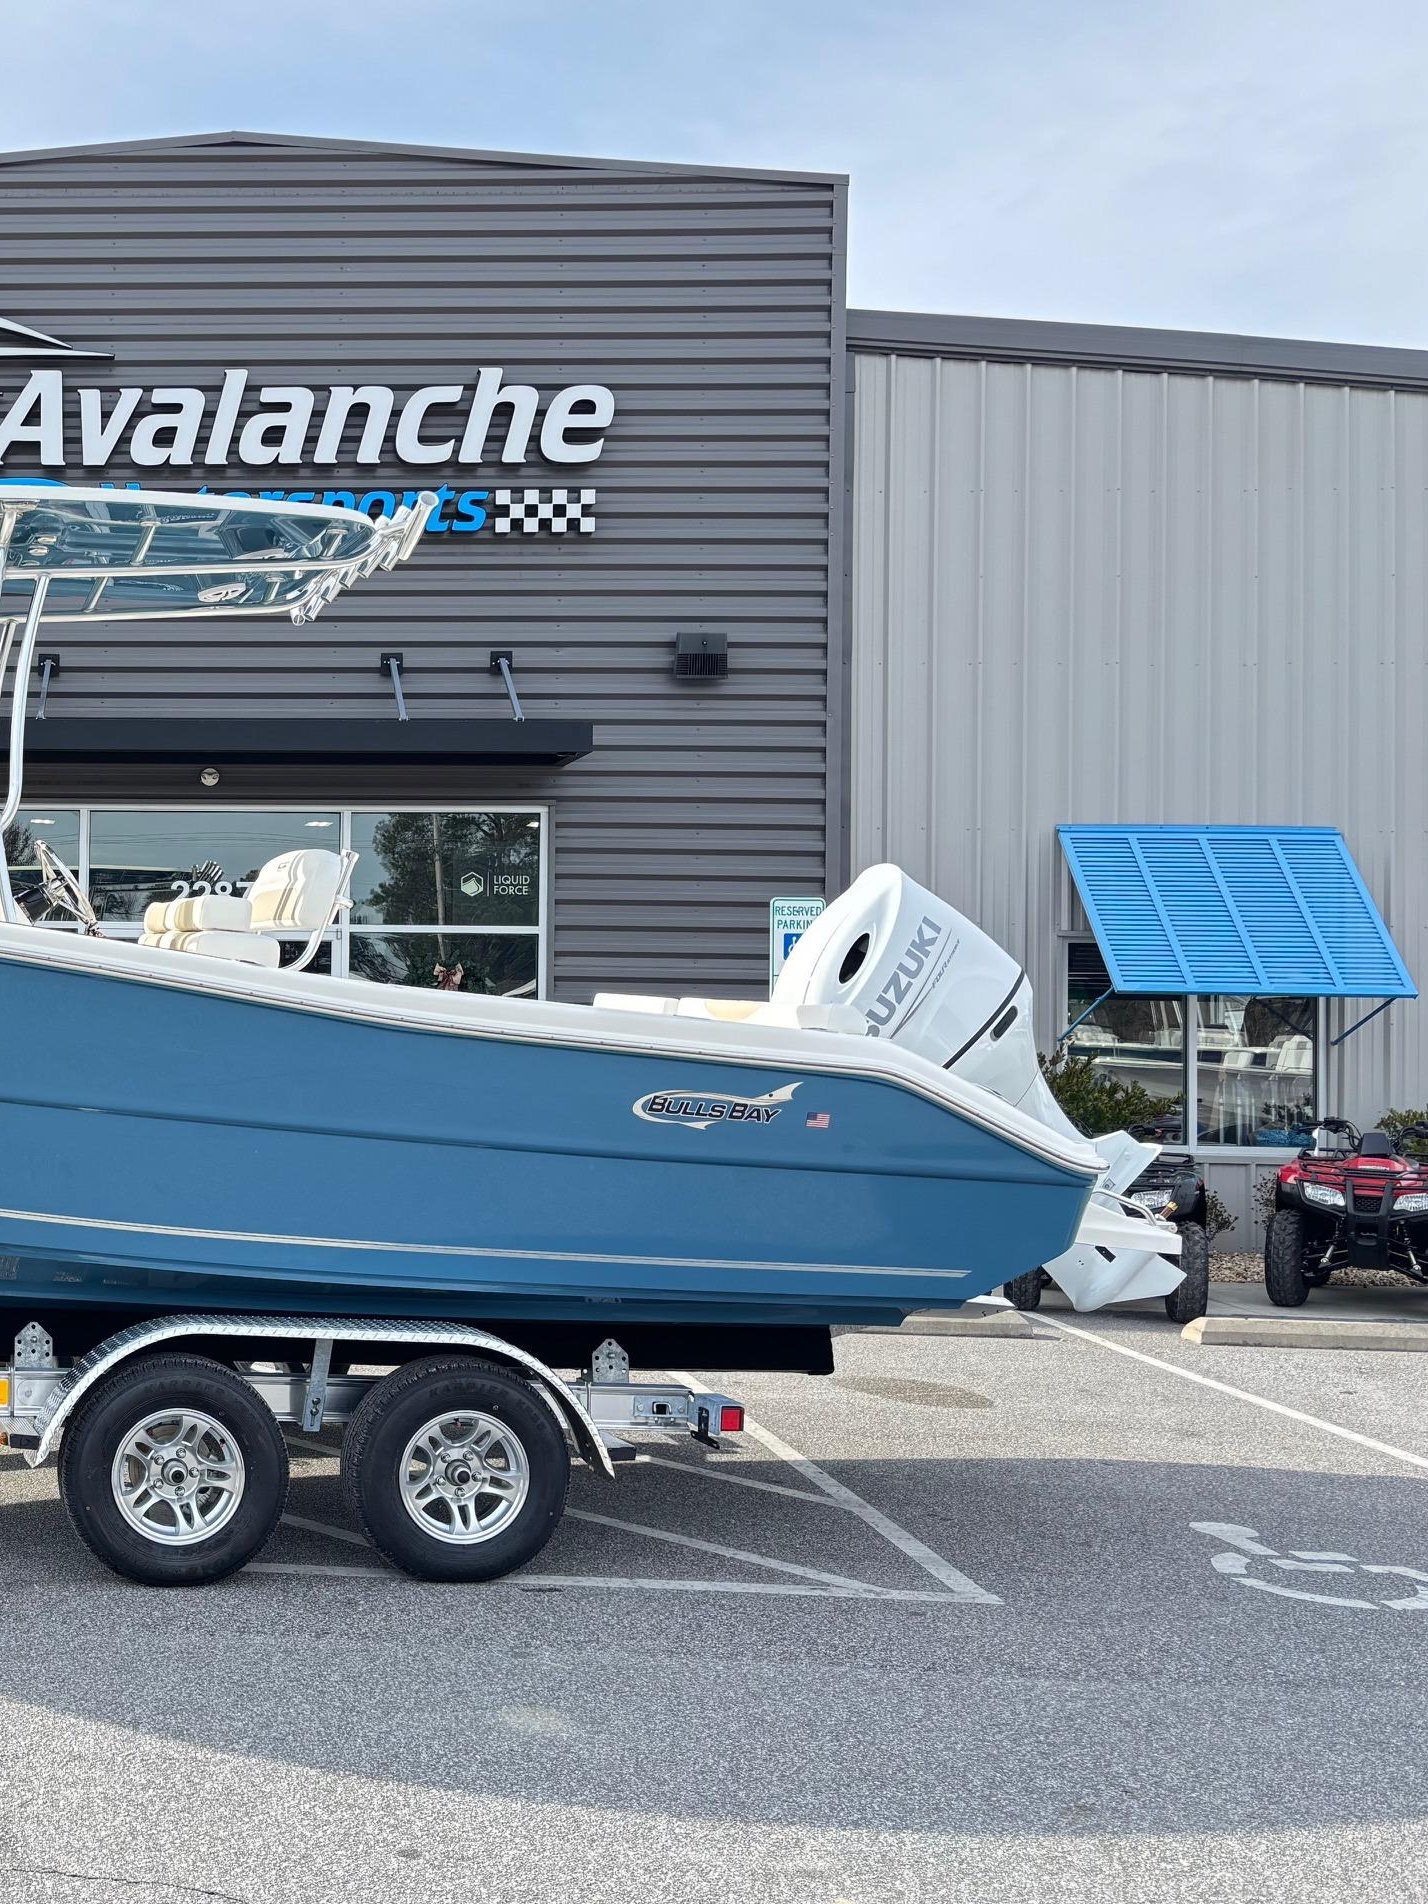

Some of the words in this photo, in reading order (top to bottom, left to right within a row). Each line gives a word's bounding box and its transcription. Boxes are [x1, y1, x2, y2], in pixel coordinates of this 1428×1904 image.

[493, 875, 530, 885] LIQUID
[493, 886, 529, 895] FORCE
[775, 906, 822, 916] RESERVED
[777, 919, 813, 930] PARKIN
[647, 1095, 727, 1120] BULLS
[727, 1101, 783, 1125] BAY
